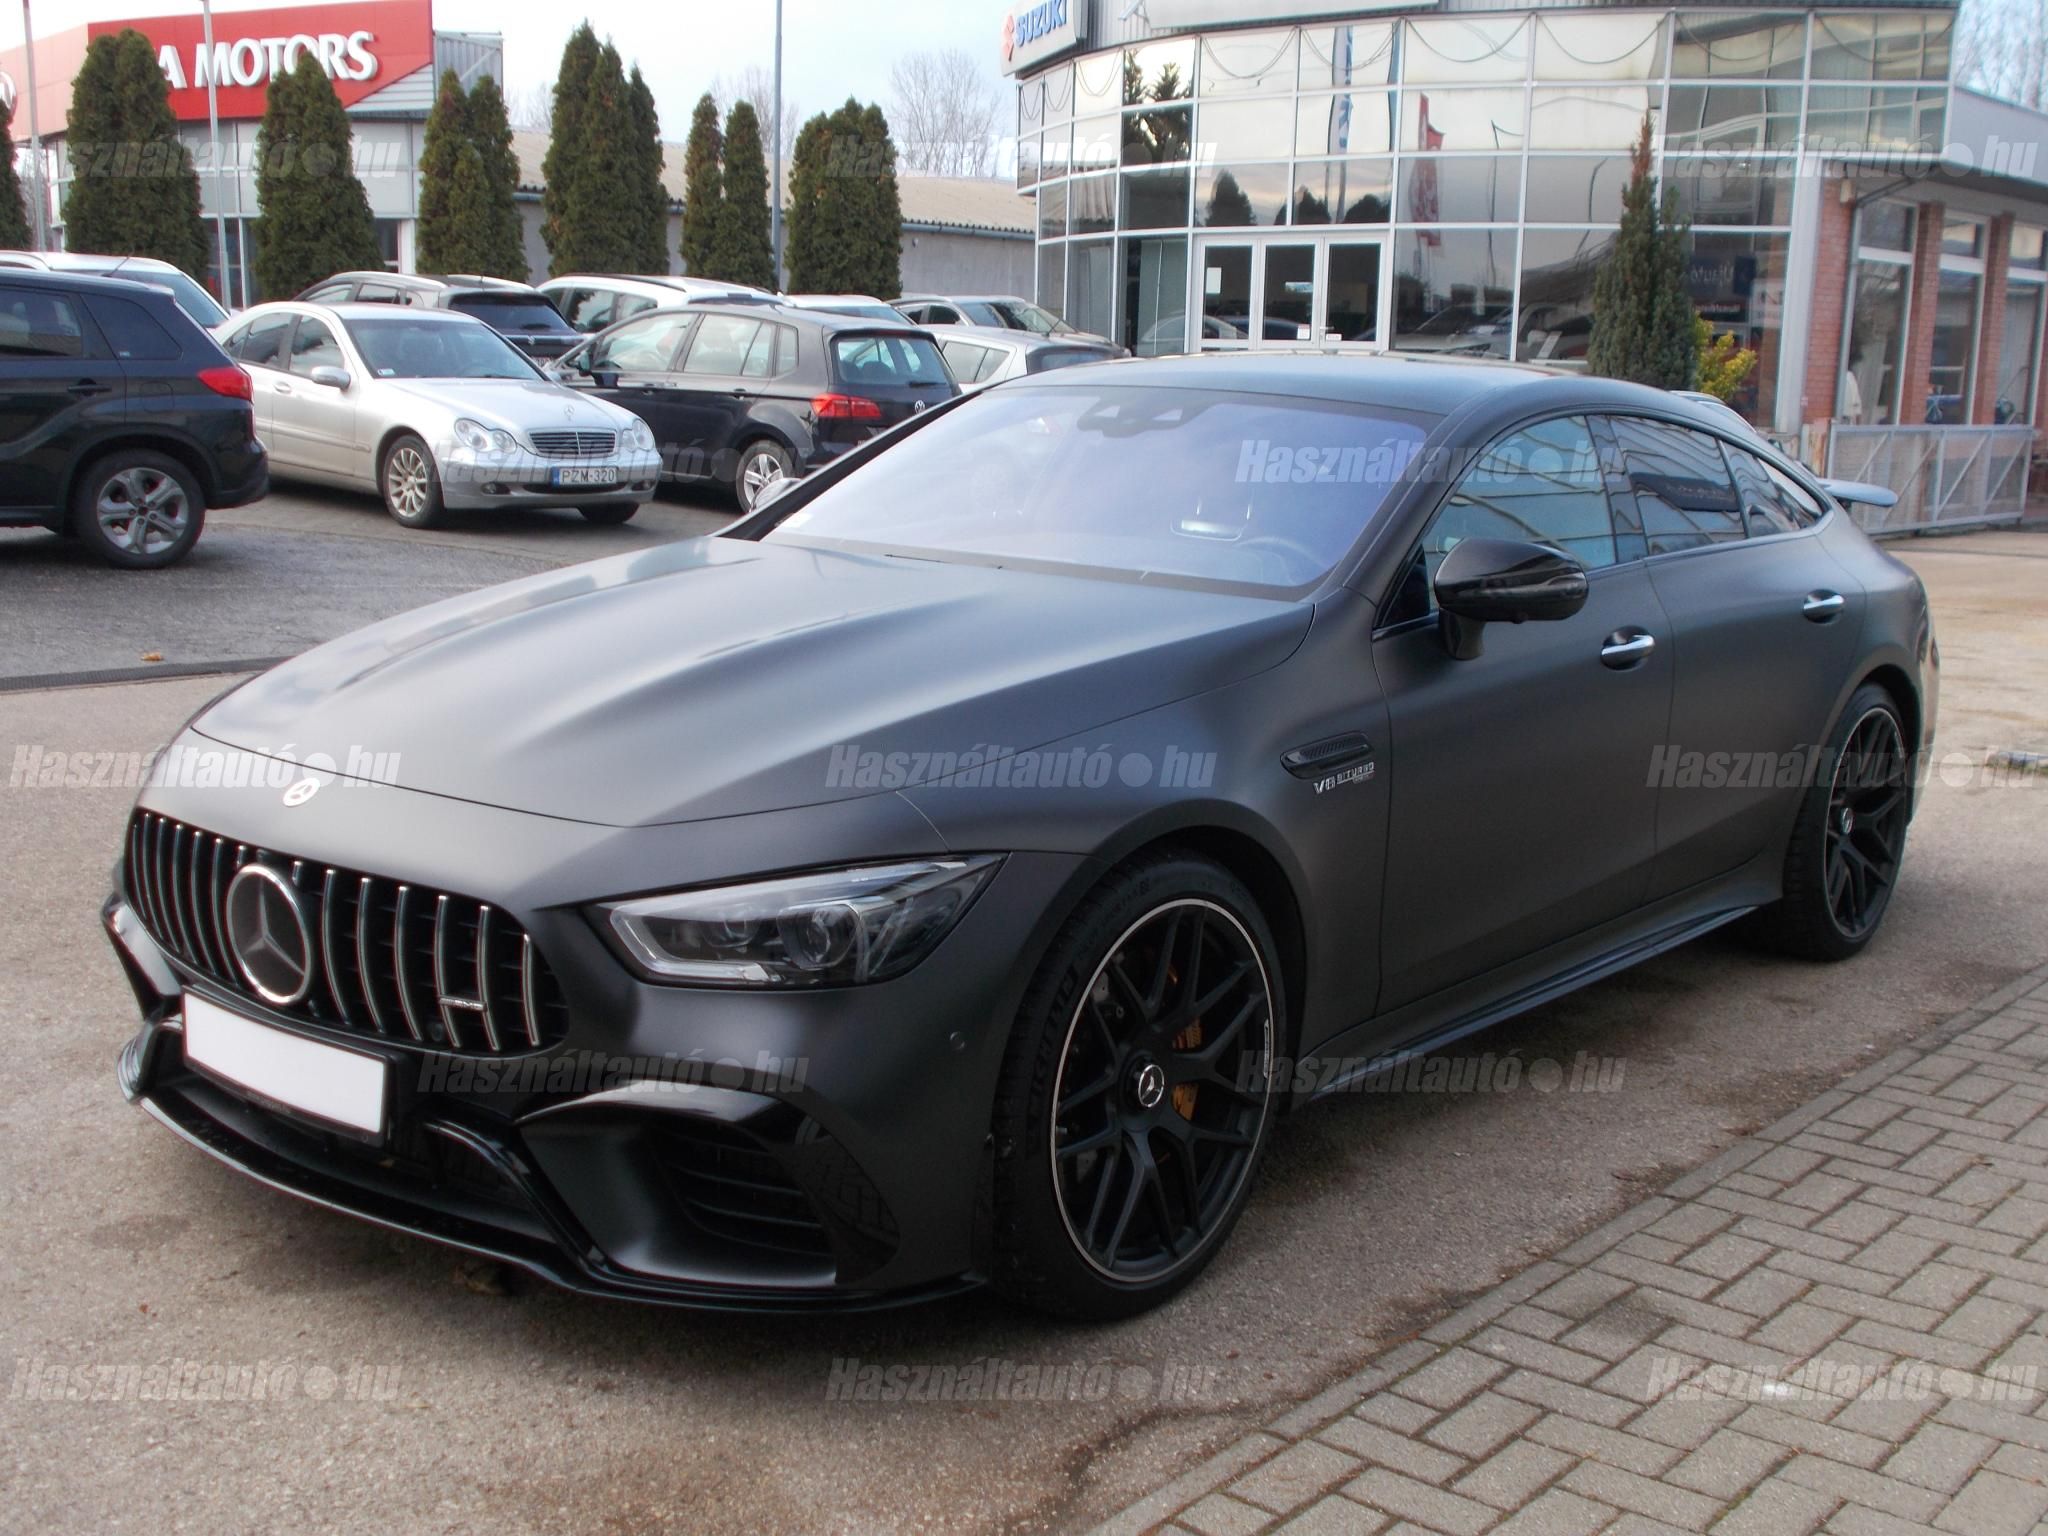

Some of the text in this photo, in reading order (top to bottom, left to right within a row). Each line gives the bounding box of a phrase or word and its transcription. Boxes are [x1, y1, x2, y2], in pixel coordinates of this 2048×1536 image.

[1015, 0, 1067, 48] SUZUKI
[195, 30, 379, 88] MOTORS
[562, 470, 615, 483] PZM-320
